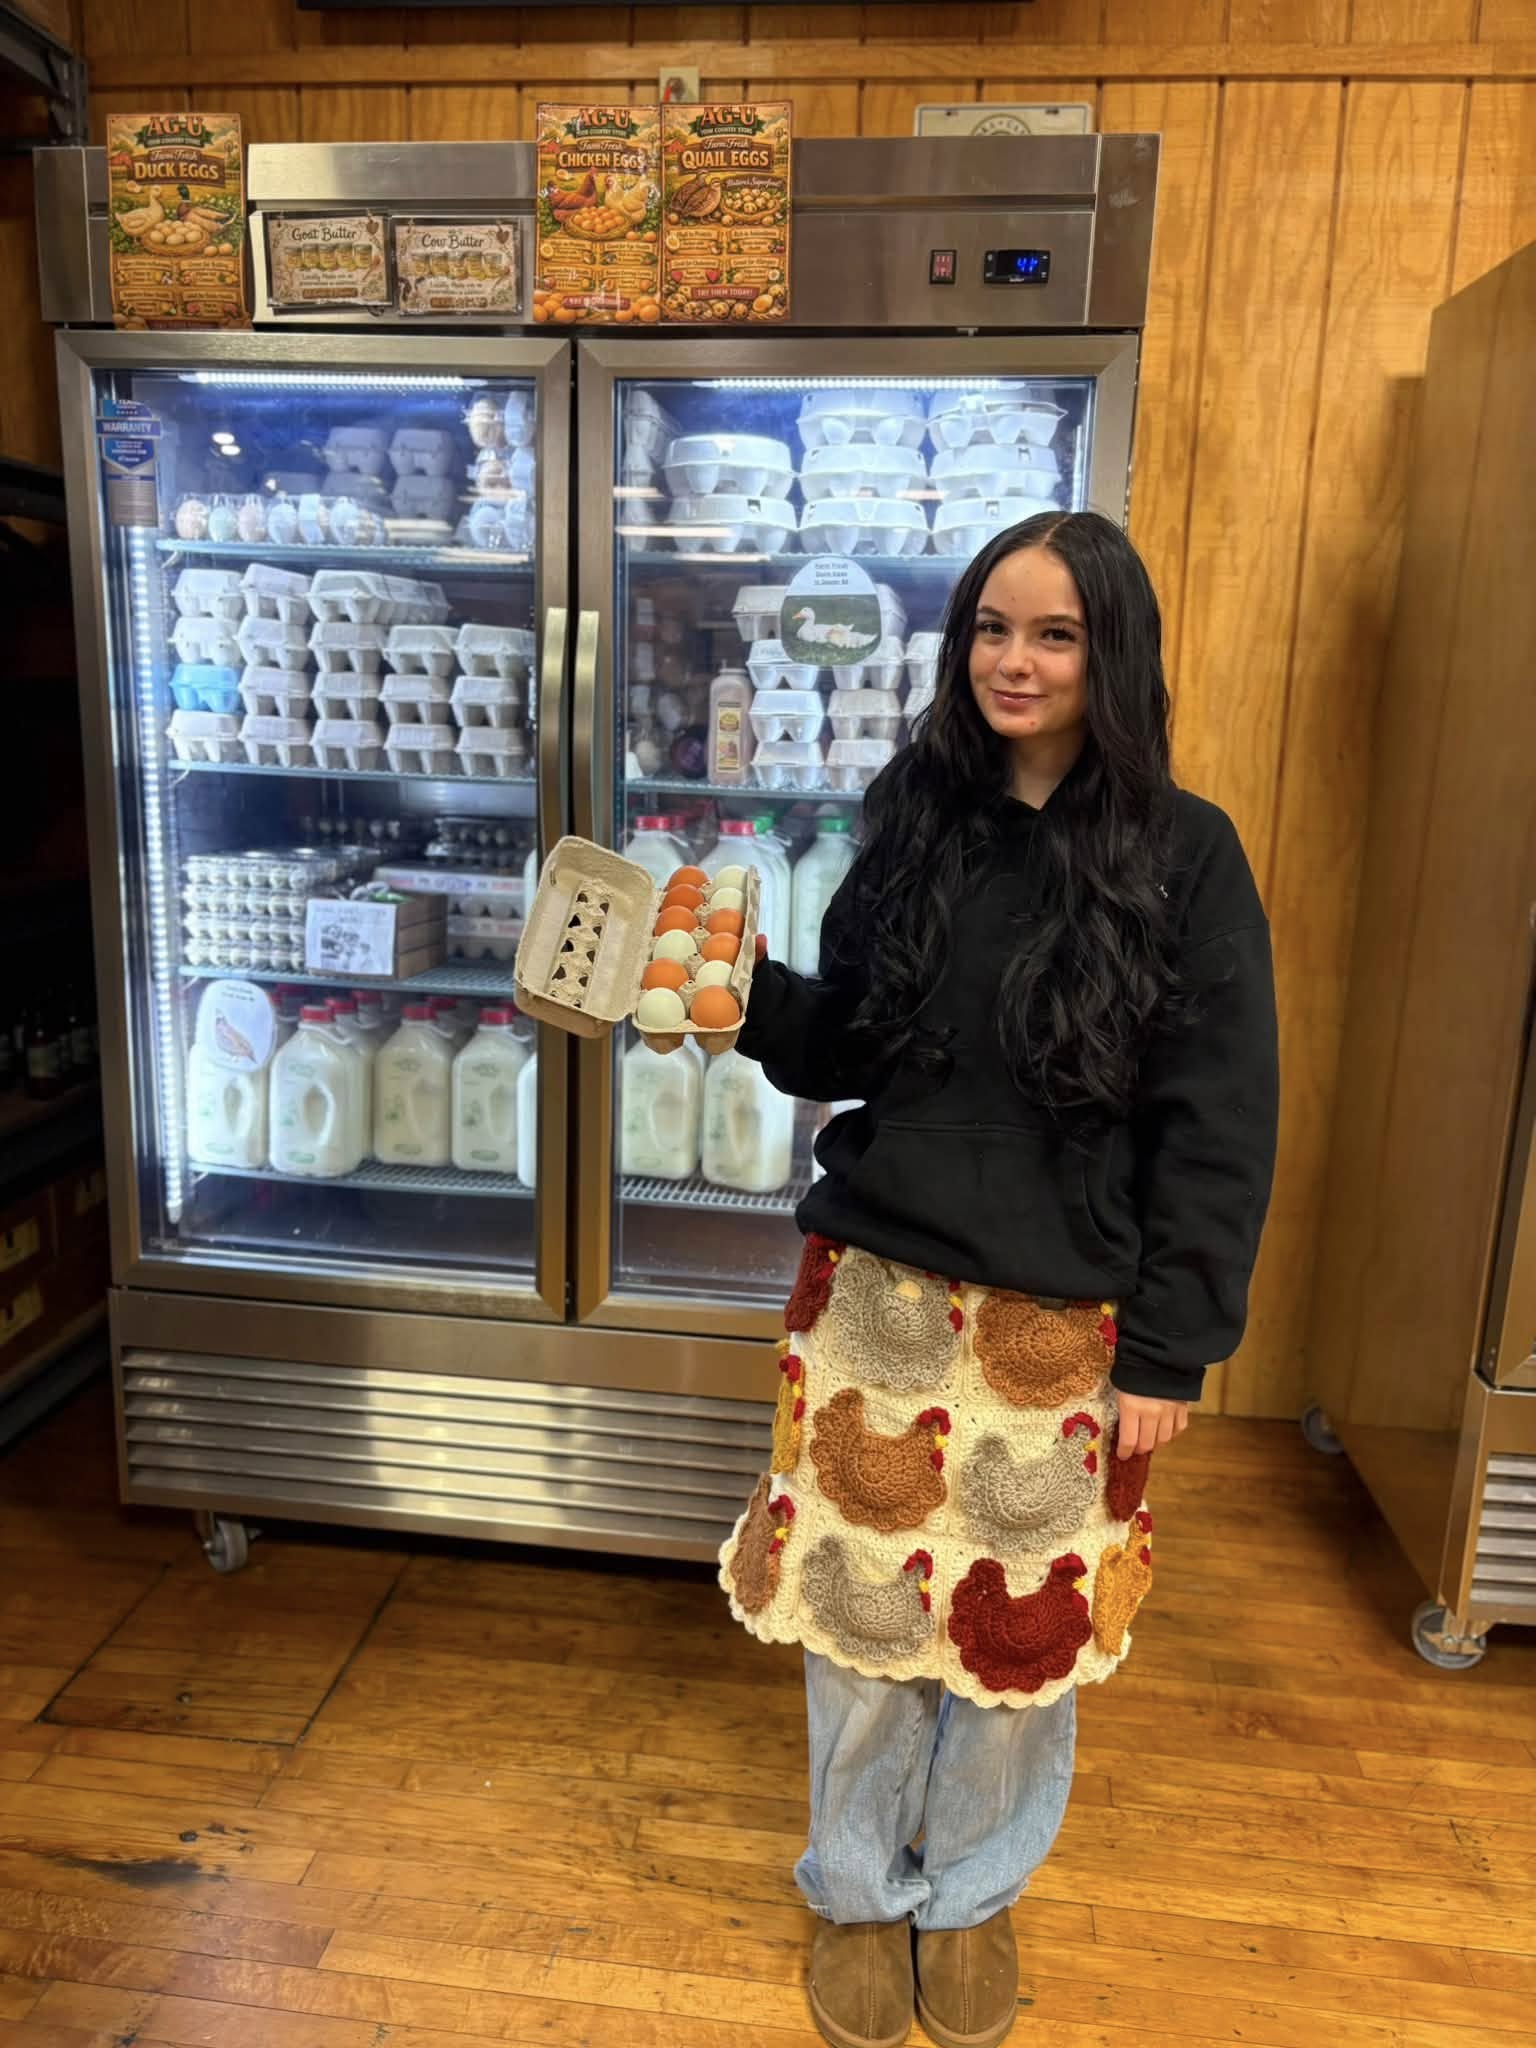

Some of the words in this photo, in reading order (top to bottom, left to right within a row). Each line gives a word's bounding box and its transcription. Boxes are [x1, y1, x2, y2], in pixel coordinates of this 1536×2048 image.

[147, 115, 204, 137] AG-U
[579, 108, 631, 129] AG-U
[700, 106, 757, 127] AG-U
[703, 139, 726, 150] Farm
[726, 138, 749, 149] Fresh
[559, 150, 610, 169] CHICKEN
[612, 152, 644, 170] EGGS
[681, 149, 728, 170] QUAIL
[730, 150, 769, 167] EGGS
[134, 162, 176, 180] DUCK
[179, 163, 219, 180] EGGS
[291, 227, 319, 241] Goat
[321, 226, 357, 241] Butter
[421, 233, 446, 248] Cow
[448, 234, 484, 249] Butter
[103, 422, 152, 433] WARRANTY
